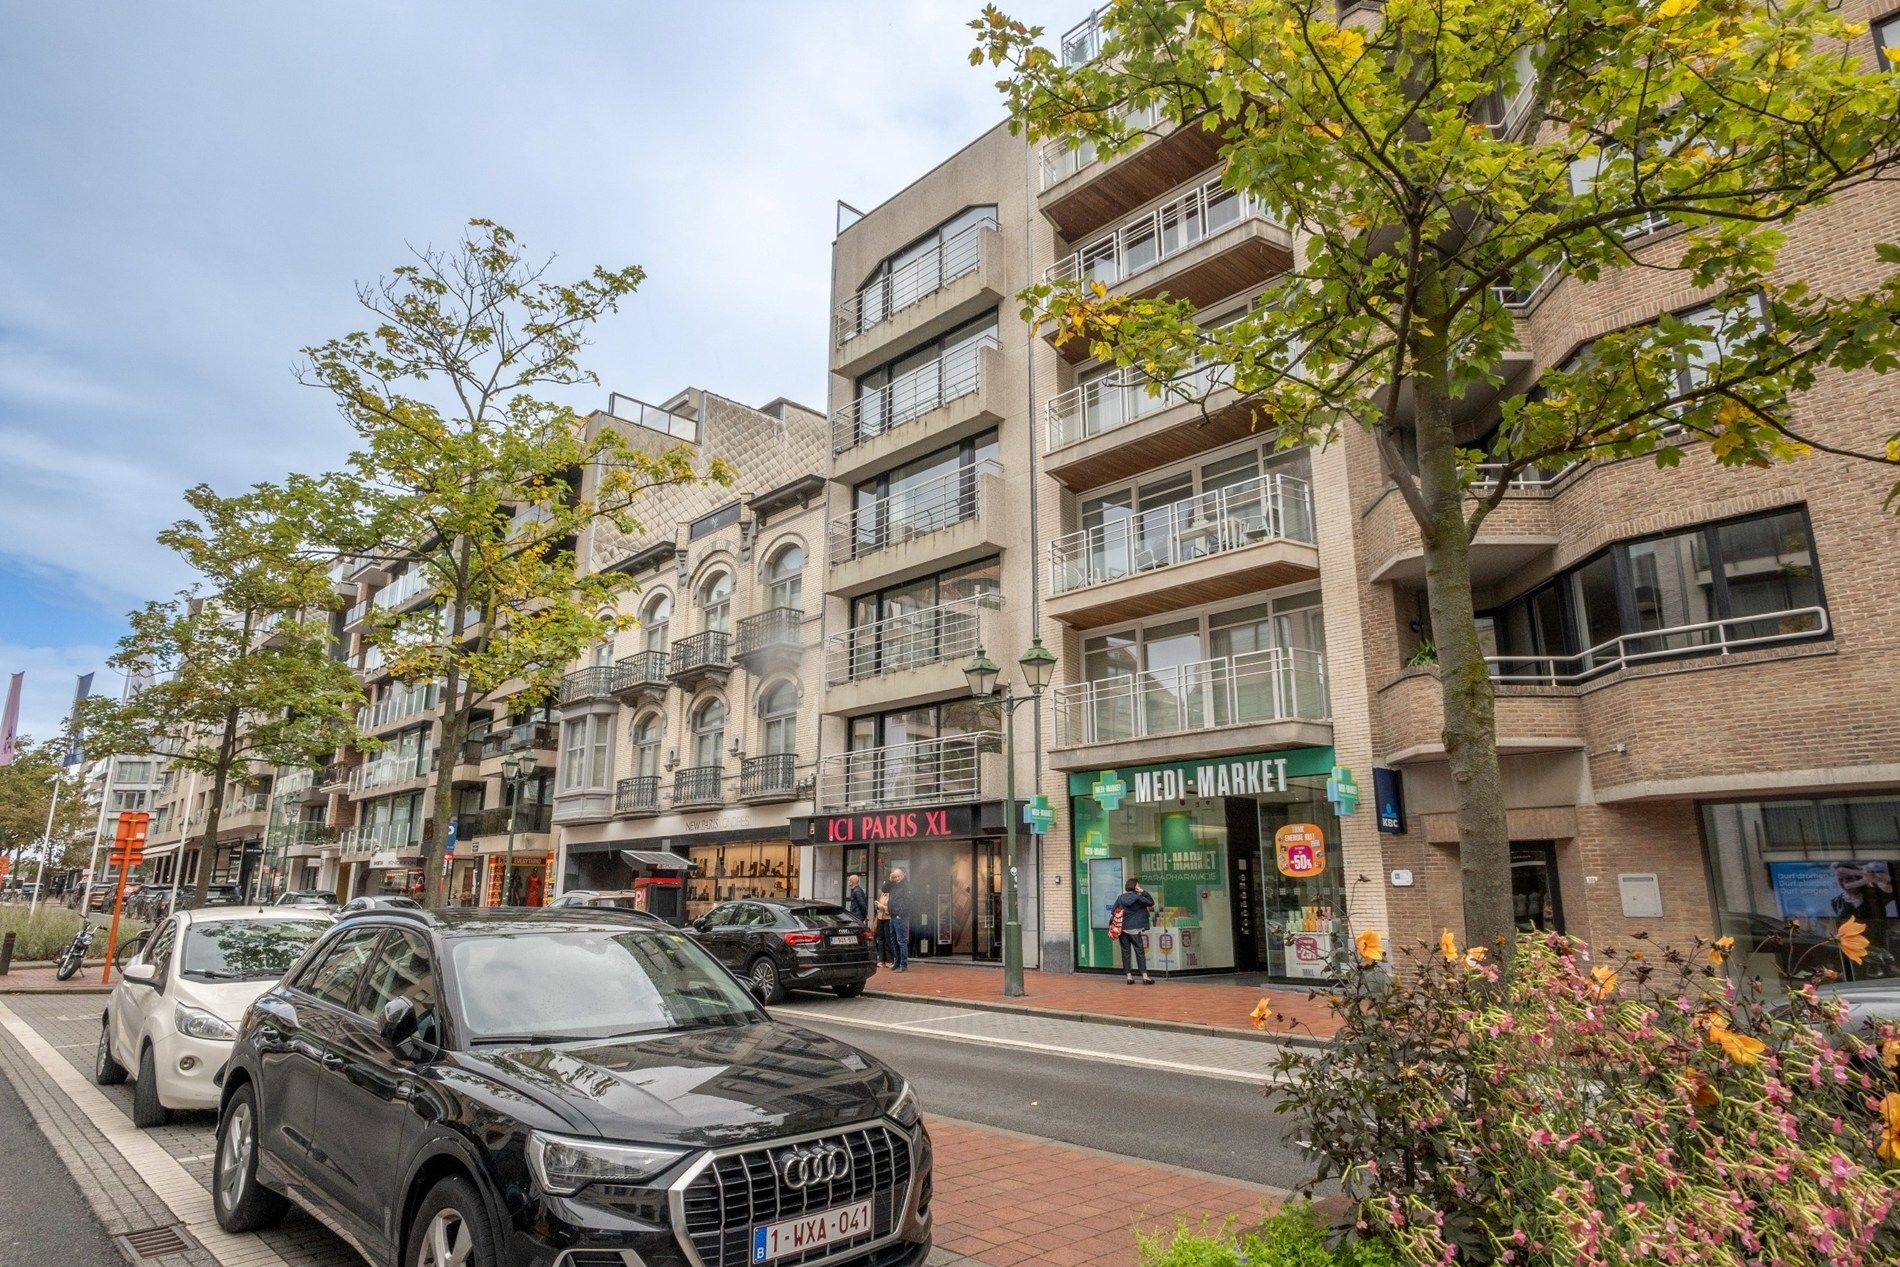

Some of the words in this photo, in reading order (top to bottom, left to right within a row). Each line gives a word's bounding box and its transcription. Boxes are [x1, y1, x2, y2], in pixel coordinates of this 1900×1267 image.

[828, 818, 853, 842] ICI
[861, 812, 917, 840] PARIS
[925, 810, 951, 836] XL
[1382, 818, 1399, 828] KBC
[1290, 854, 1313, 870] -50%
[770, 1205, 868, 1253] 1-WXA-041
[757, 1247, 765, 1259] B
